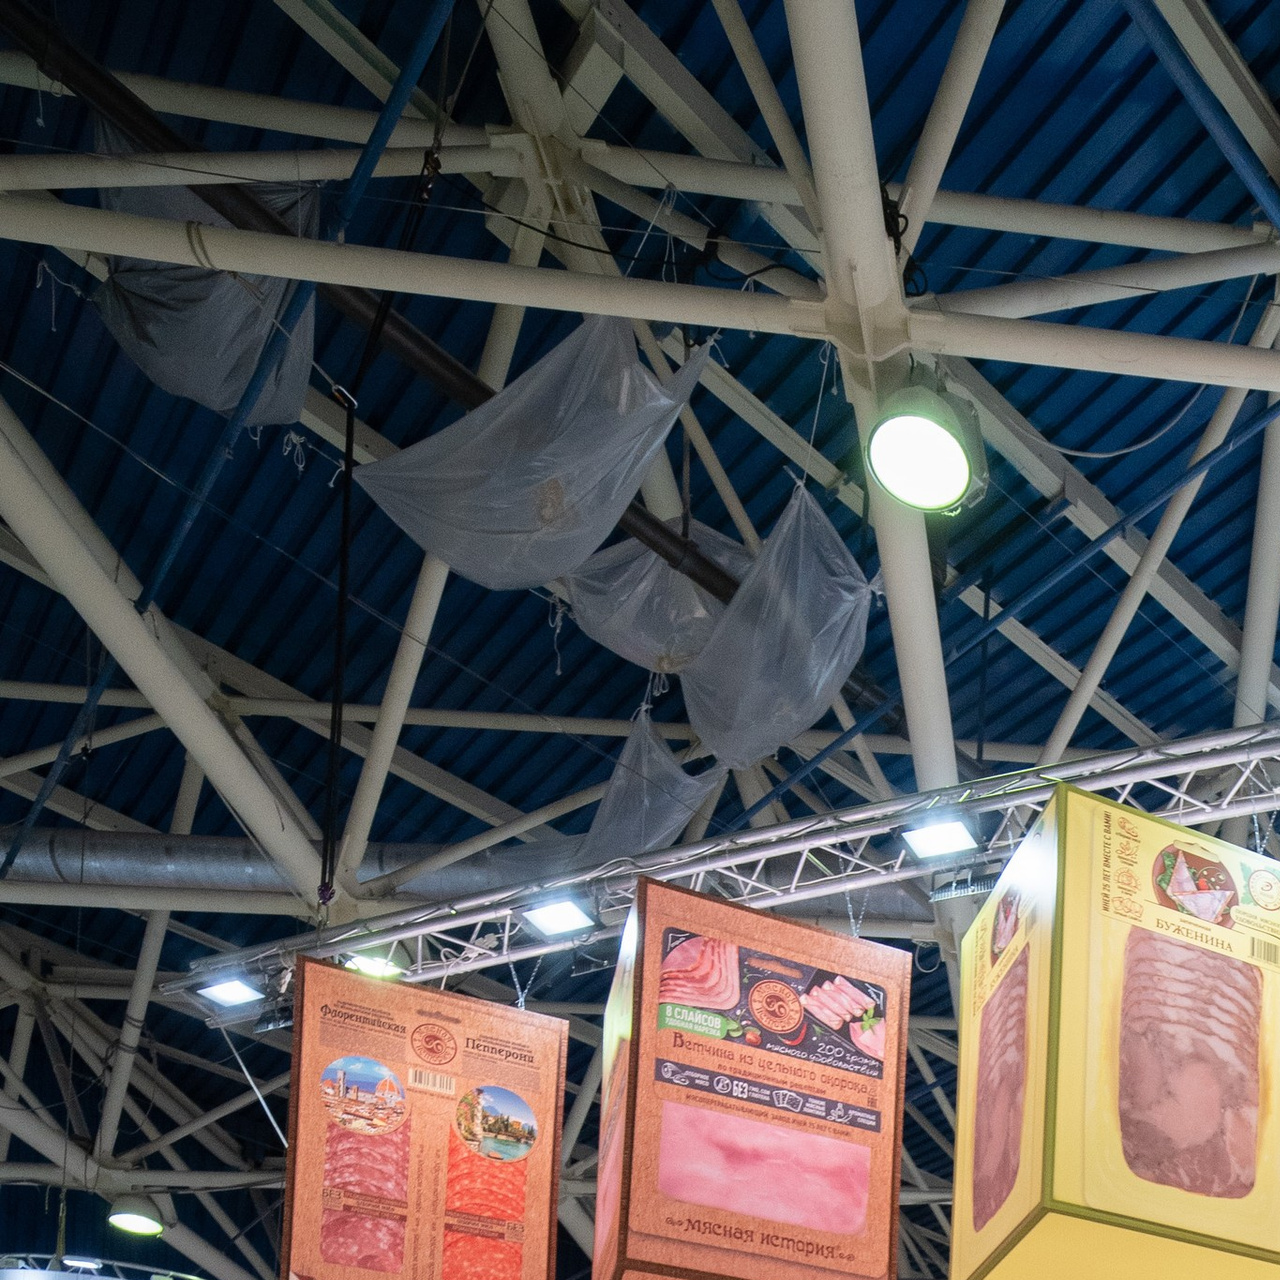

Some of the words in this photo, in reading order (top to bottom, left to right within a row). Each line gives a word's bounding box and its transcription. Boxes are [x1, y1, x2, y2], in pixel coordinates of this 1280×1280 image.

[1155, 918, 1234, 953] БУЖЕНИНА
[665, 1005, 673, 1017] 8
[674, 1006, 722, 1029] СЛАЙСОВ
[465, 1037, 535, 1063] Пепперони
[817, 1042, 845, 1057] 200
[672, 1031, 735, 1061] Ветчина
[739, 1053, 754, 1066] из
[758, 1057, 817, 1081] цельного
[820, 1073, 868, 1094] окорока
[732, 1080, 748, 1098] БЕЗ
[321, 1188, 342, 1200] БЕЗ
